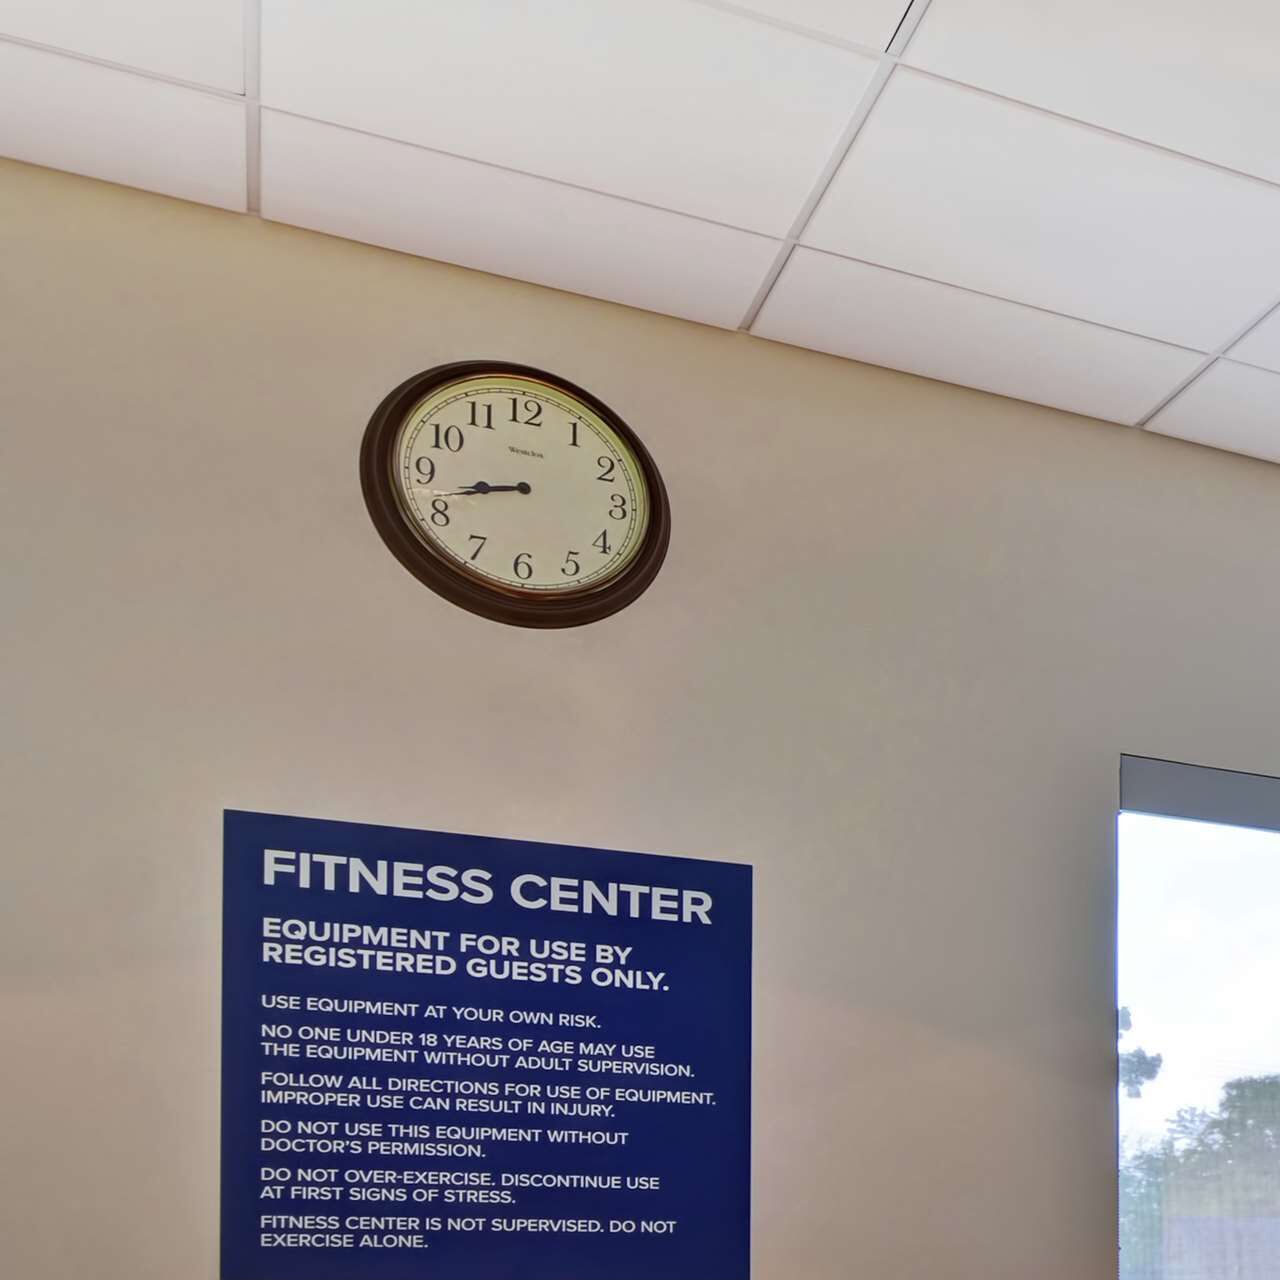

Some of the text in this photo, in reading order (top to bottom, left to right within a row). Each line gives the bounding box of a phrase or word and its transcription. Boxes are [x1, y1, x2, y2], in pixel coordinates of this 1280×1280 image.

[466, 401, 495, 430] 11
[508, 397, 543, 427] 12
[430, 423, 464, 453] 10
[568, 422, 581, 448] 1
[415, 456, 435, 484] 9
[596, 456, 615, 482] 2
[431, 499, 450, 527] 8
[608, 494, 627, 520] 3
[467, 534, 487, 561] 7
[591, 529, 612, 554] 4
[513, 552, 533, 580] 6
[560, 551, 581, 576] 5
[263, 849, 713, 925] FITNESS CENTER
[263, 917, 633, 965] EQUIPMENT FOR USE BY
[263, 942, 670, 991] REGISTERED GUESTS ONLY.
[261, 994, 601, 1029] USE EQUIPMENT AT YOUR OWN RISK.
[261, 1024, 655, 1059] NO ONE UNDER 18 YEARS OF AGE MAY USE
[260, 1042, 695, 1077] THE EQUIPMENT WITHOUT ADULT SUPERVISION.
[261, 1071, 716, 1105] FOLLOW ALL DIRECTIONS FOR USE OF EQUIPMENT.
[261, 1090, 615, 1118] IMPROPER USE CAN RESULT IN INJURY.
[261, 1119, 629, 1145] DO NOT USE THIS EQUIPMENT WITHOUT
[367, 1141, 486, 1158] PERMISSION.
[260, 1167, 660, 1190] DO NOT OVER-EXERCISE. DISCONTINUE USE
[260, 1185, 516, 1204] AT FIRST SIGNS OF STRESS.
[260, 1215, 677, 1234] FITNESS CENTER IS NOT SUPERVISED. DO NOT
[261, 1233, 428, 1248] EXERCISE ALONE.
